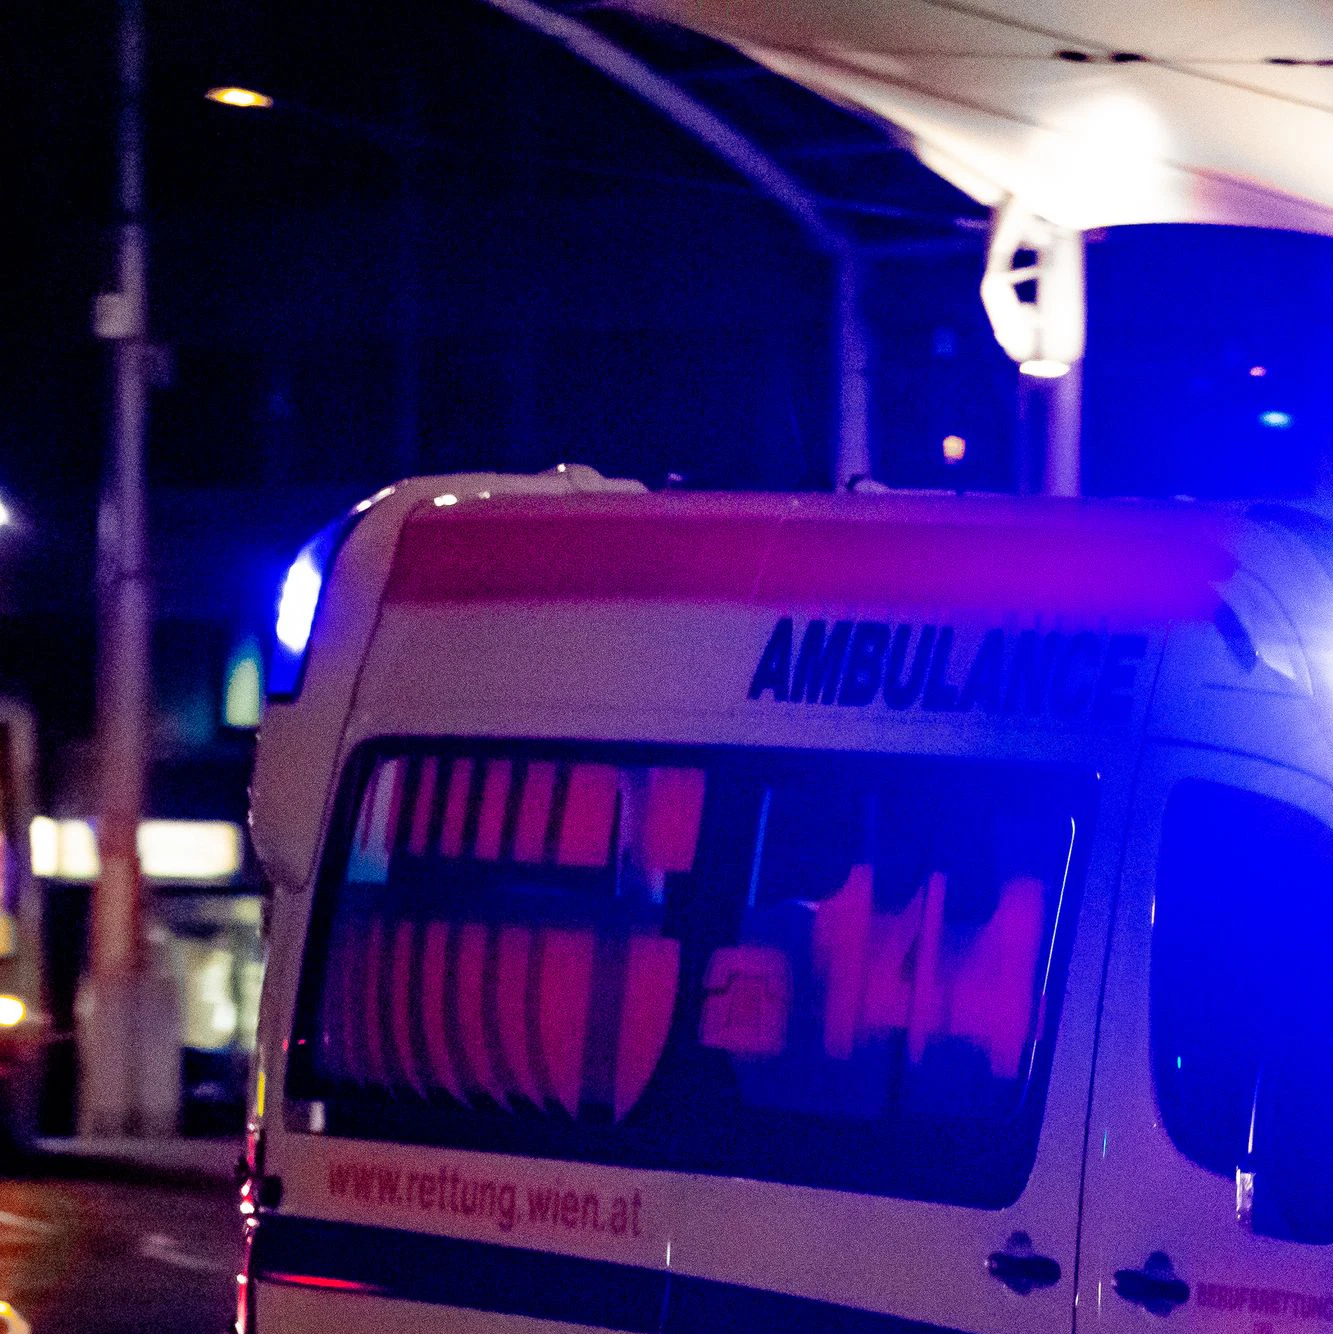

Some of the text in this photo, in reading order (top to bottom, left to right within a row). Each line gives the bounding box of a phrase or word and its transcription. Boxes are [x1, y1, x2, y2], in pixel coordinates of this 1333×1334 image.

[748, 617, 1147, 722] AMBULANCE
[327, 1160, 643, 1237] www.rettung.wien.at
[1197, 1282, 1333, 1321] BERUFSRETTUNG
